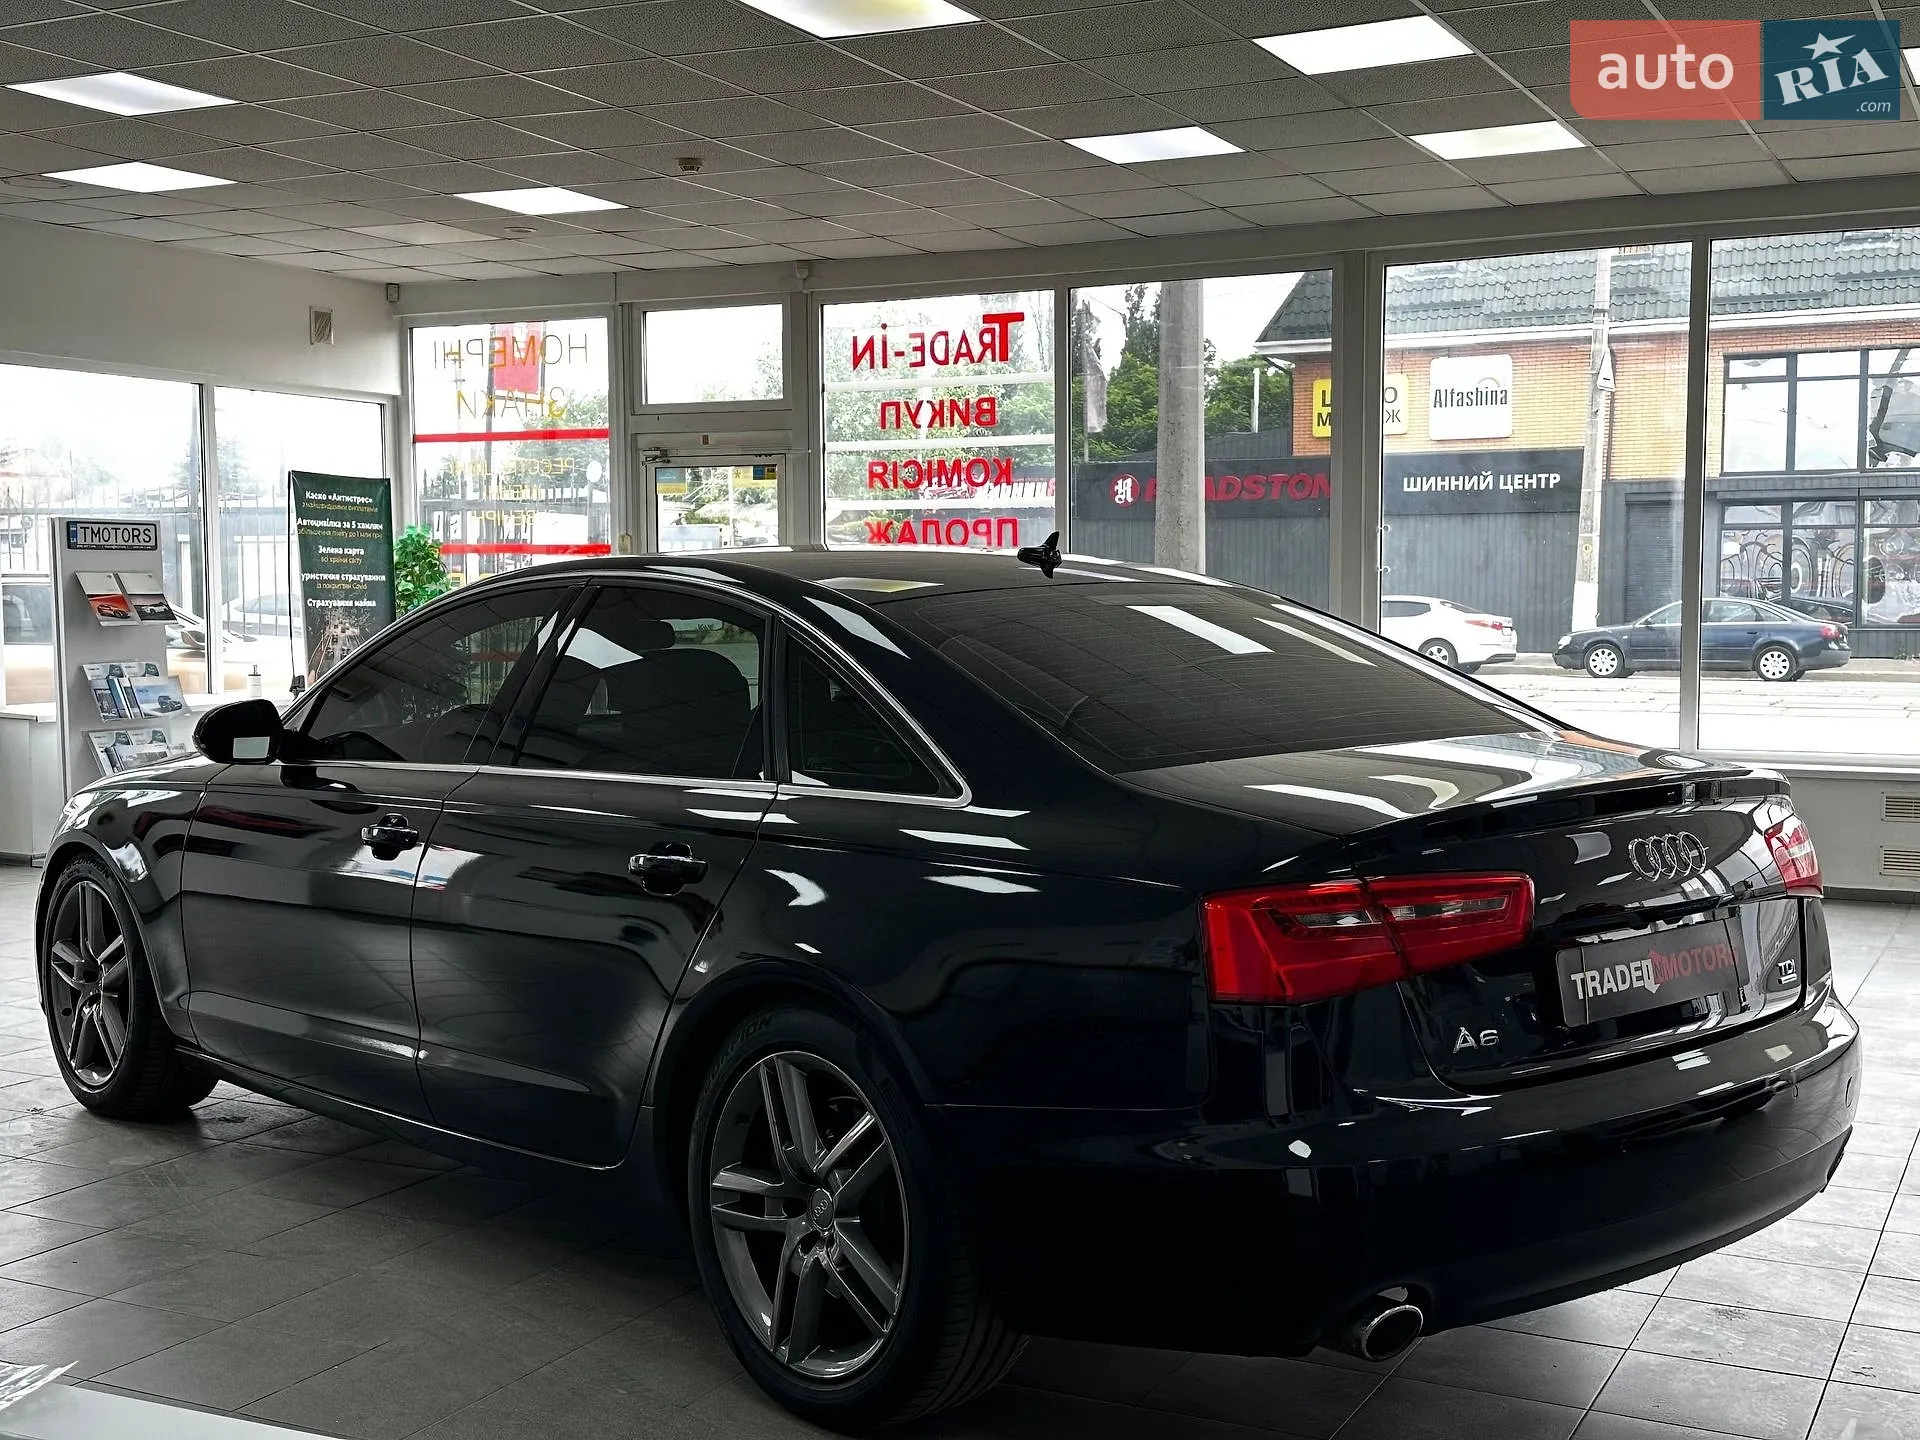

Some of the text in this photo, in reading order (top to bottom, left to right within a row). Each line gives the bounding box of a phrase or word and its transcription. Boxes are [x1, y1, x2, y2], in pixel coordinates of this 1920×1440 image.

[1433, 387, 1508, 408] Alfashina
[1403, 471, 1561, 494] ШИННИЙ ЦЕНТР
[305, 490, 327, 500] Каско
[80, 526, 152, 543] TMOTORS
[318, 545, 364, 556] Зелена карта
[1453, 1027, 1499, 1053] A6
